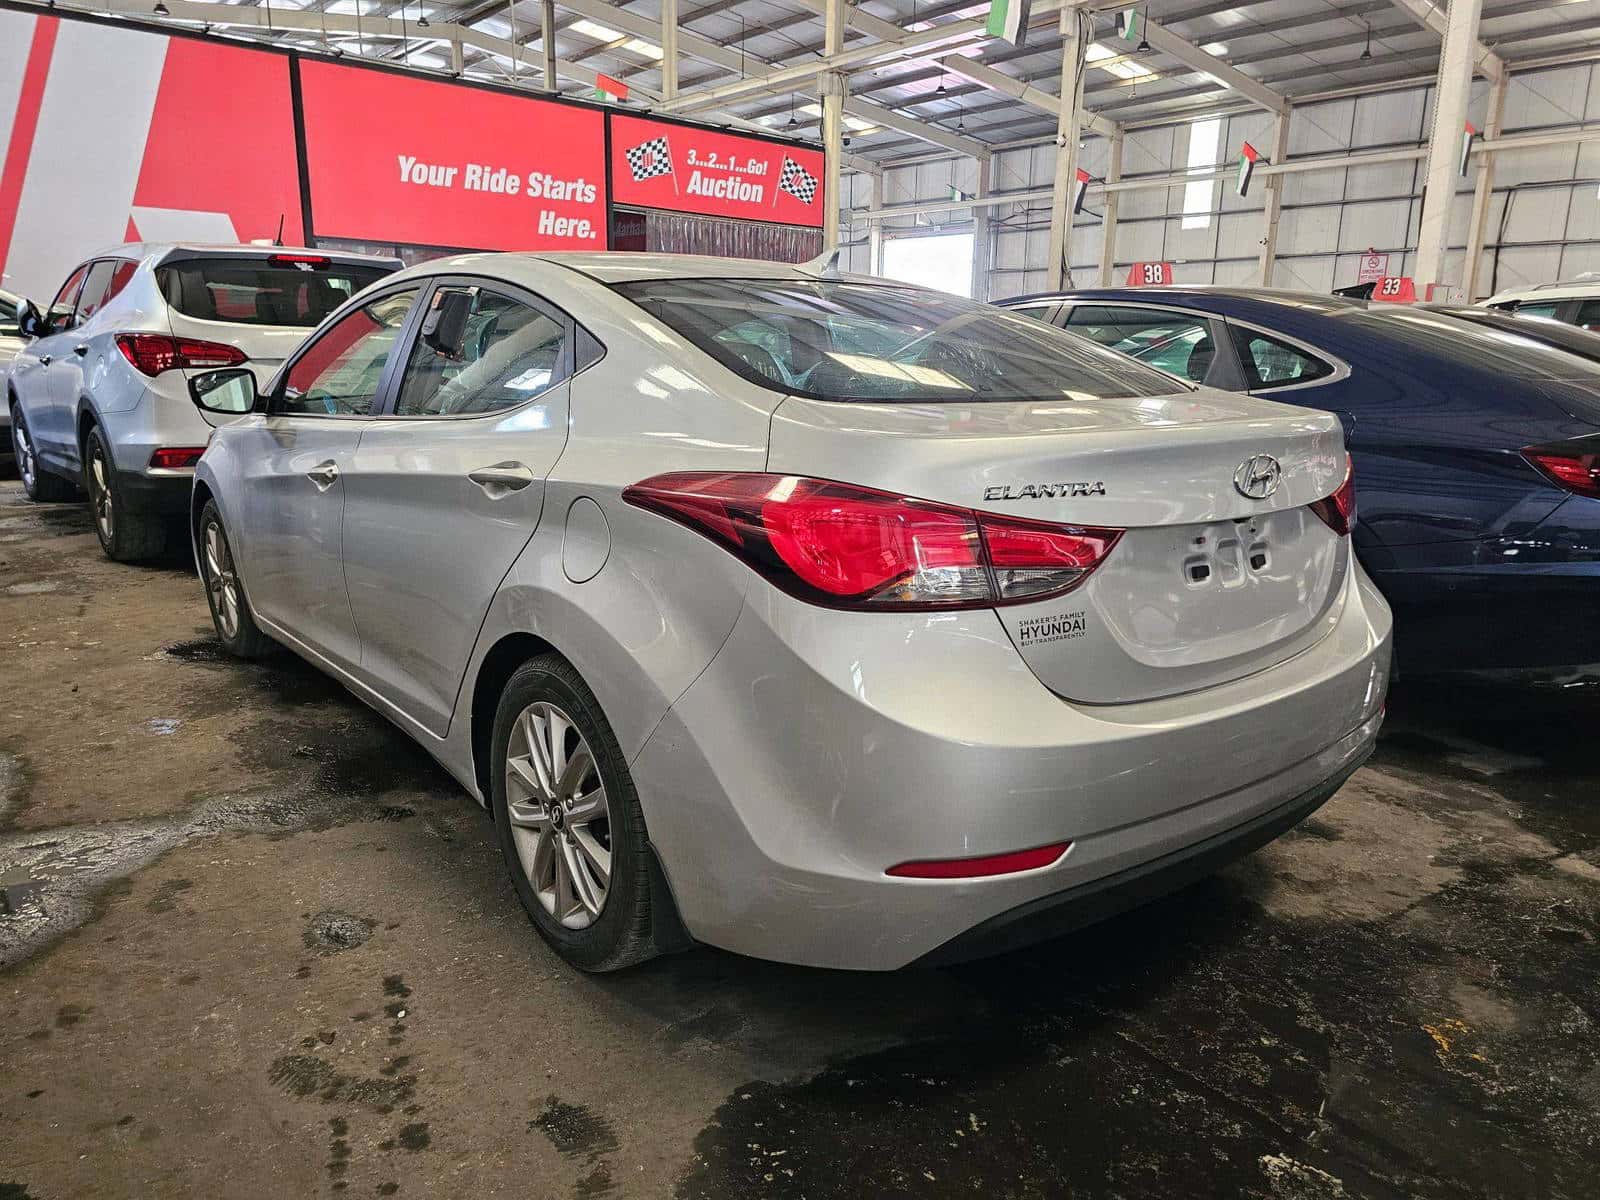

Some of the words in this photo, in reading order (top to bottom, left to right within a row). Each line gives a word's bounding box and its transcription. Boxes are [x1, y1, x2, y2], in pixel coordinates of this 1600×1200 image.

[398, 155, 458, 188] Your
[464, 163, 521, 194] Ride
[527, 171, 597, 204] Starts
[686, 171, 764, 203] Auction
[537, 210, 597, 239] Here.
[1143, 264, 1163, 284] 38
[1382, 278, 1401, 295] 33
[983, 481, 1106, 501] ELANTRA
[1018, 615, 1057, 627] SHAKER'S
[1060, 611, 1085, 621] FAMILY
[1020, 618, 1086, 640] HYUNDAI
[1021, 639, 1034, 647] BUY
